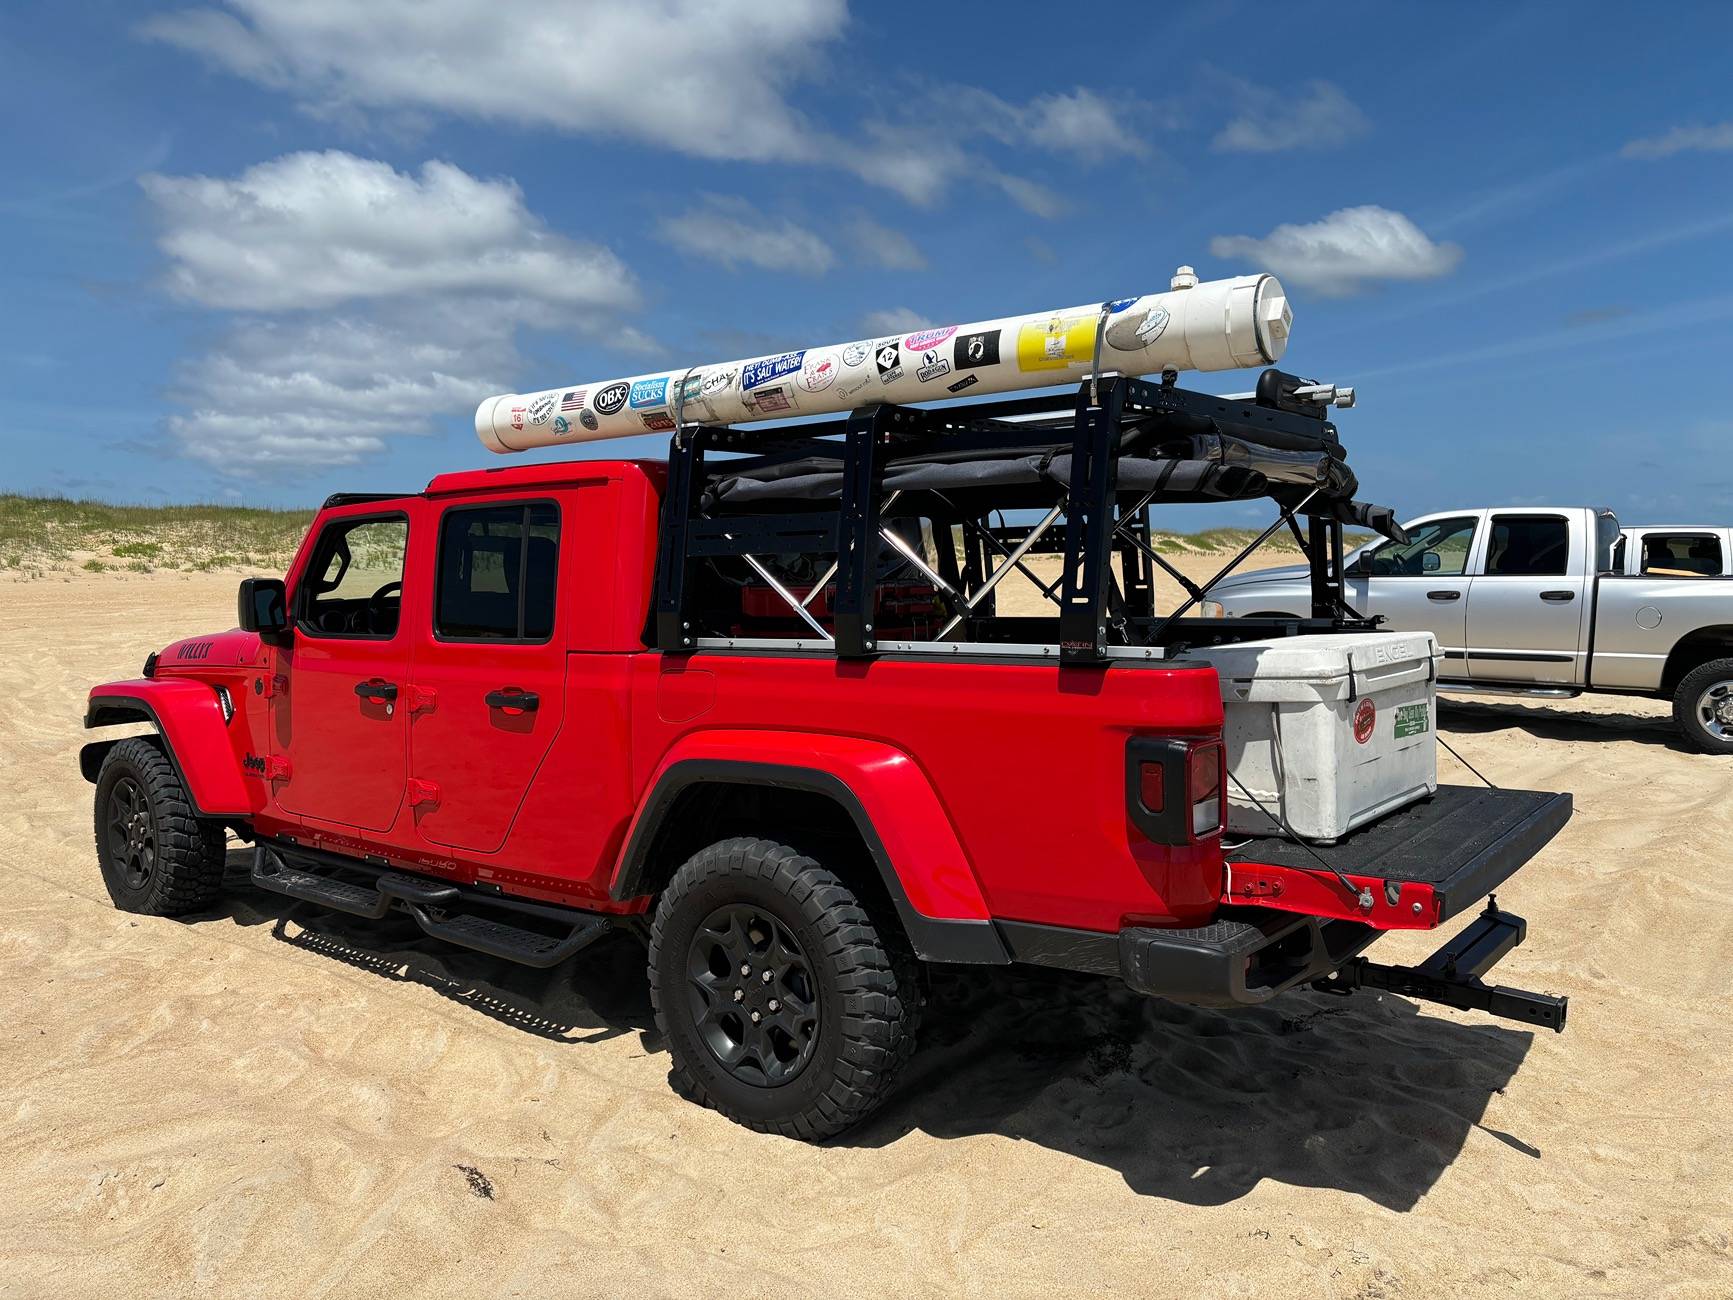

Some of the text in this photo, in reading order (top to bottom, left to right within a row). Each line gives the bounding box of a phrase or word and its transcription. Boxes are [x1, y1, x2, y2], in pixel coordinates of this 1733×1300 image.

[882, 352, 893, 362] 12
[757, 365, 773, 381] SALT
[632, 388, 663, 401] SUCKS
[634, 381, 665, 392] Socialism
[600, 387, 623, 407] OBX
[177, 642, 214, 660] WILLYS
[243, 751, 265, 773] Jeep
